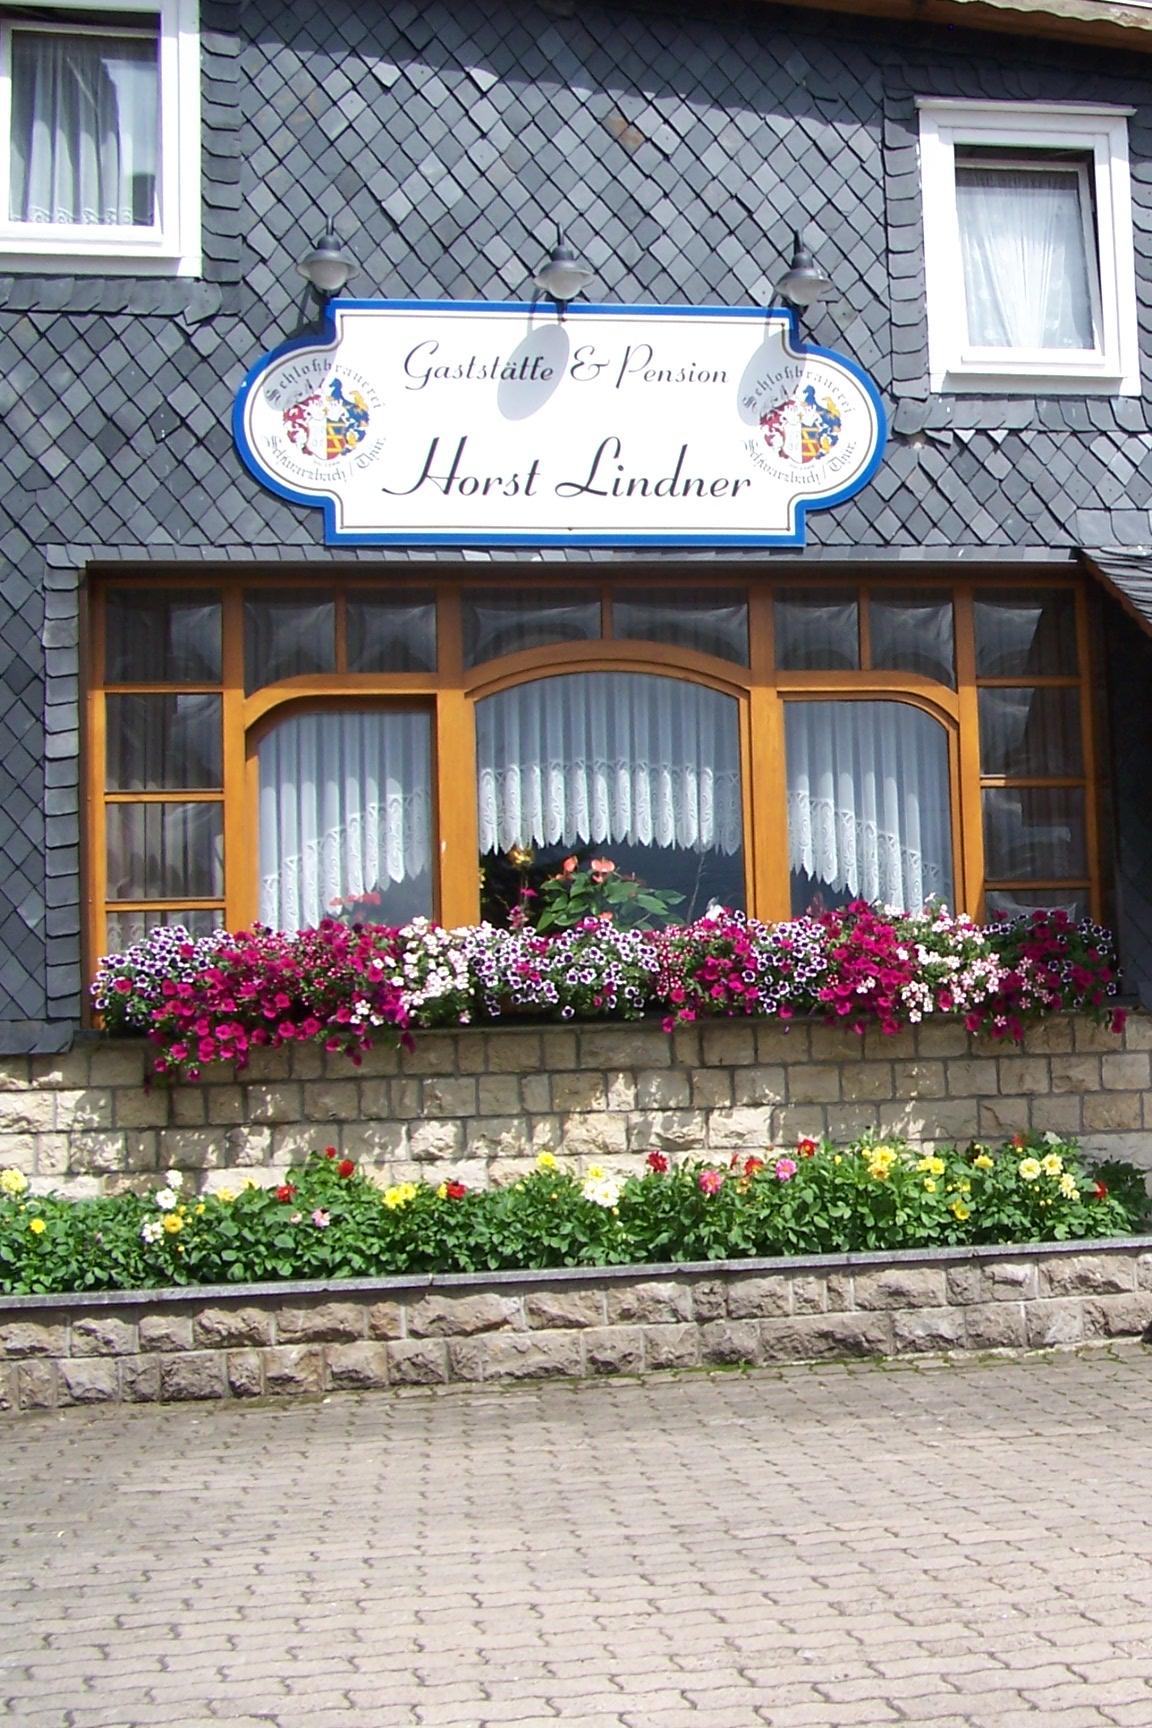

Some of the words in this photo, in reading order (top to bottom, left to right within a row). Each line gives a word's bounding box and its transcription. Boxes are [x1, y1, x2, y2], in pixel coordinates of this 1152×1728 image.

[404, 340, 554, 390] Gaststätte
[570, 346, 610, 381] &
[615, 344, 728, 389] Pension
[381, 435, 540, 496] Horst
[555, 436, 751, 497] Lindner
